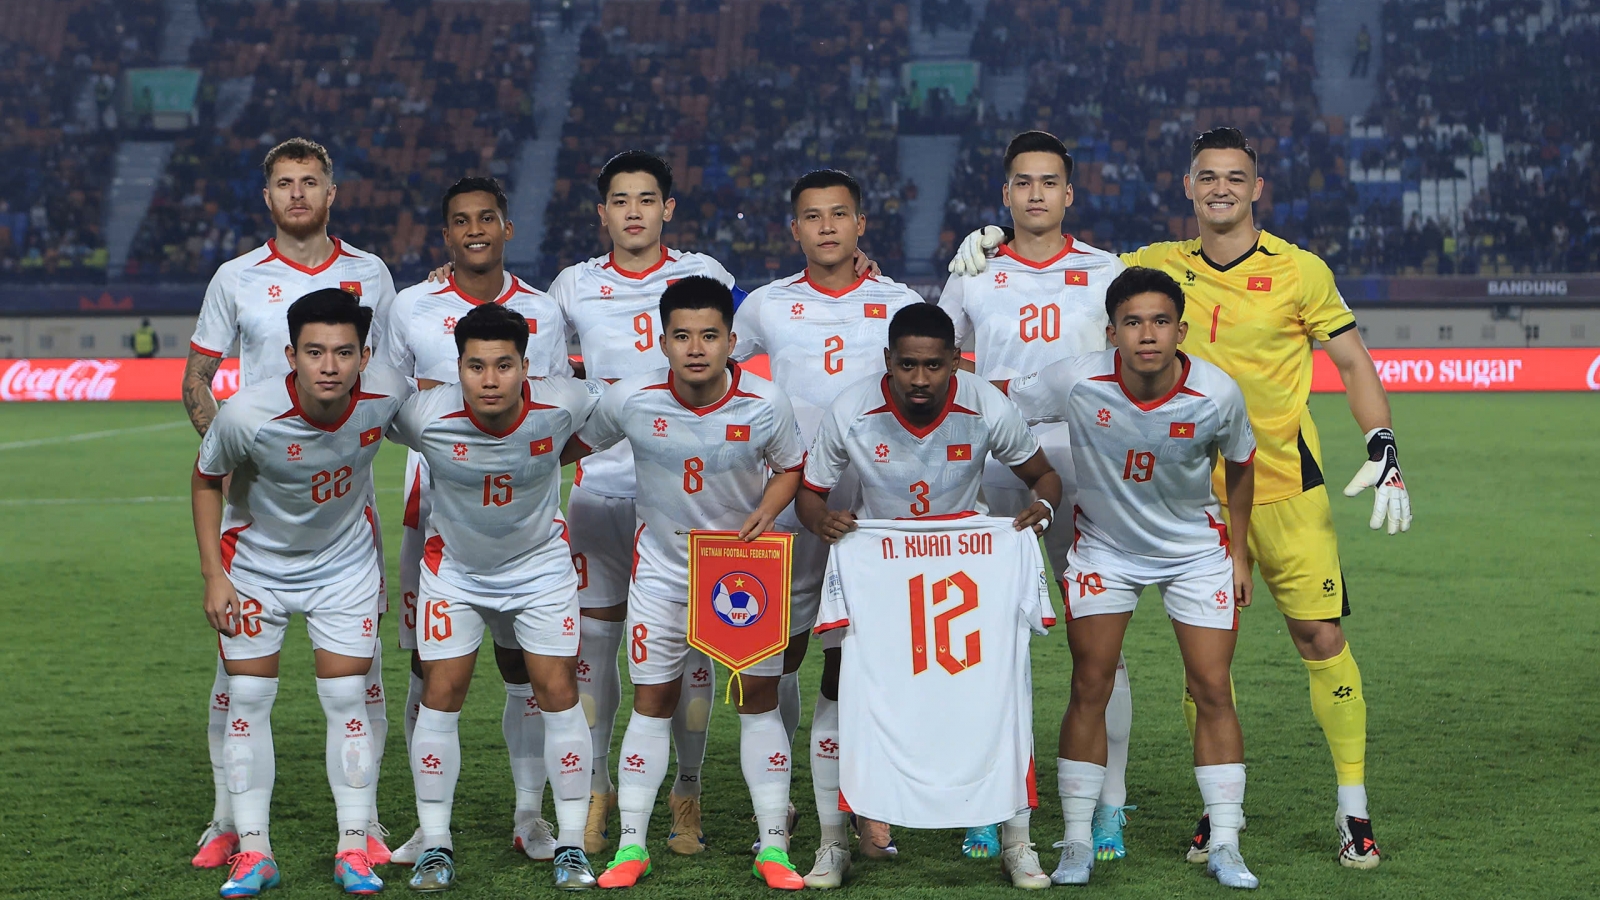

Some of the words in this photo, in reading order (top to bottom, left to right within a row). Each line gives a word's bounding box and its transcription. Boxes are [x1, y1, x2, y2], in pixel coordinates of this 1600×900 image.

[1487, 280, 1568, 295] BANDUNG
[633, 312, 654, 353] 9
[1019, 303, 1060, 343] 20
[1210, 304, 1221, 343] 1
[824, 335, 844, 375] 2
[1374, 360, 1434, 383] zero
[1439, 359, 1522, 388] sugar
[311, 465, 353, 504] 22
[683, 456, 704, 495] 8
[1123, 449, 1156, 483] 19
[483, 474, 513, 507] 15
[909, 480, 931, 518] 3
[700, 546, 723, 557] VIETNAM
[724, 548, 749, 558] FOOTBALL
[750, 549, 781, 560] FEDERATION
[881, 536, 899, 560] N.
[905, 534, 951, 559] XUAN
[958, 532, 993, 555] SON
[574, 552, 589, 592] 9
[424, 600, 453, 643] 15
[731, 612, 748, 620] VFF
[908, 570, 982, 676] 12
[631, 623, 648, 665] 8
